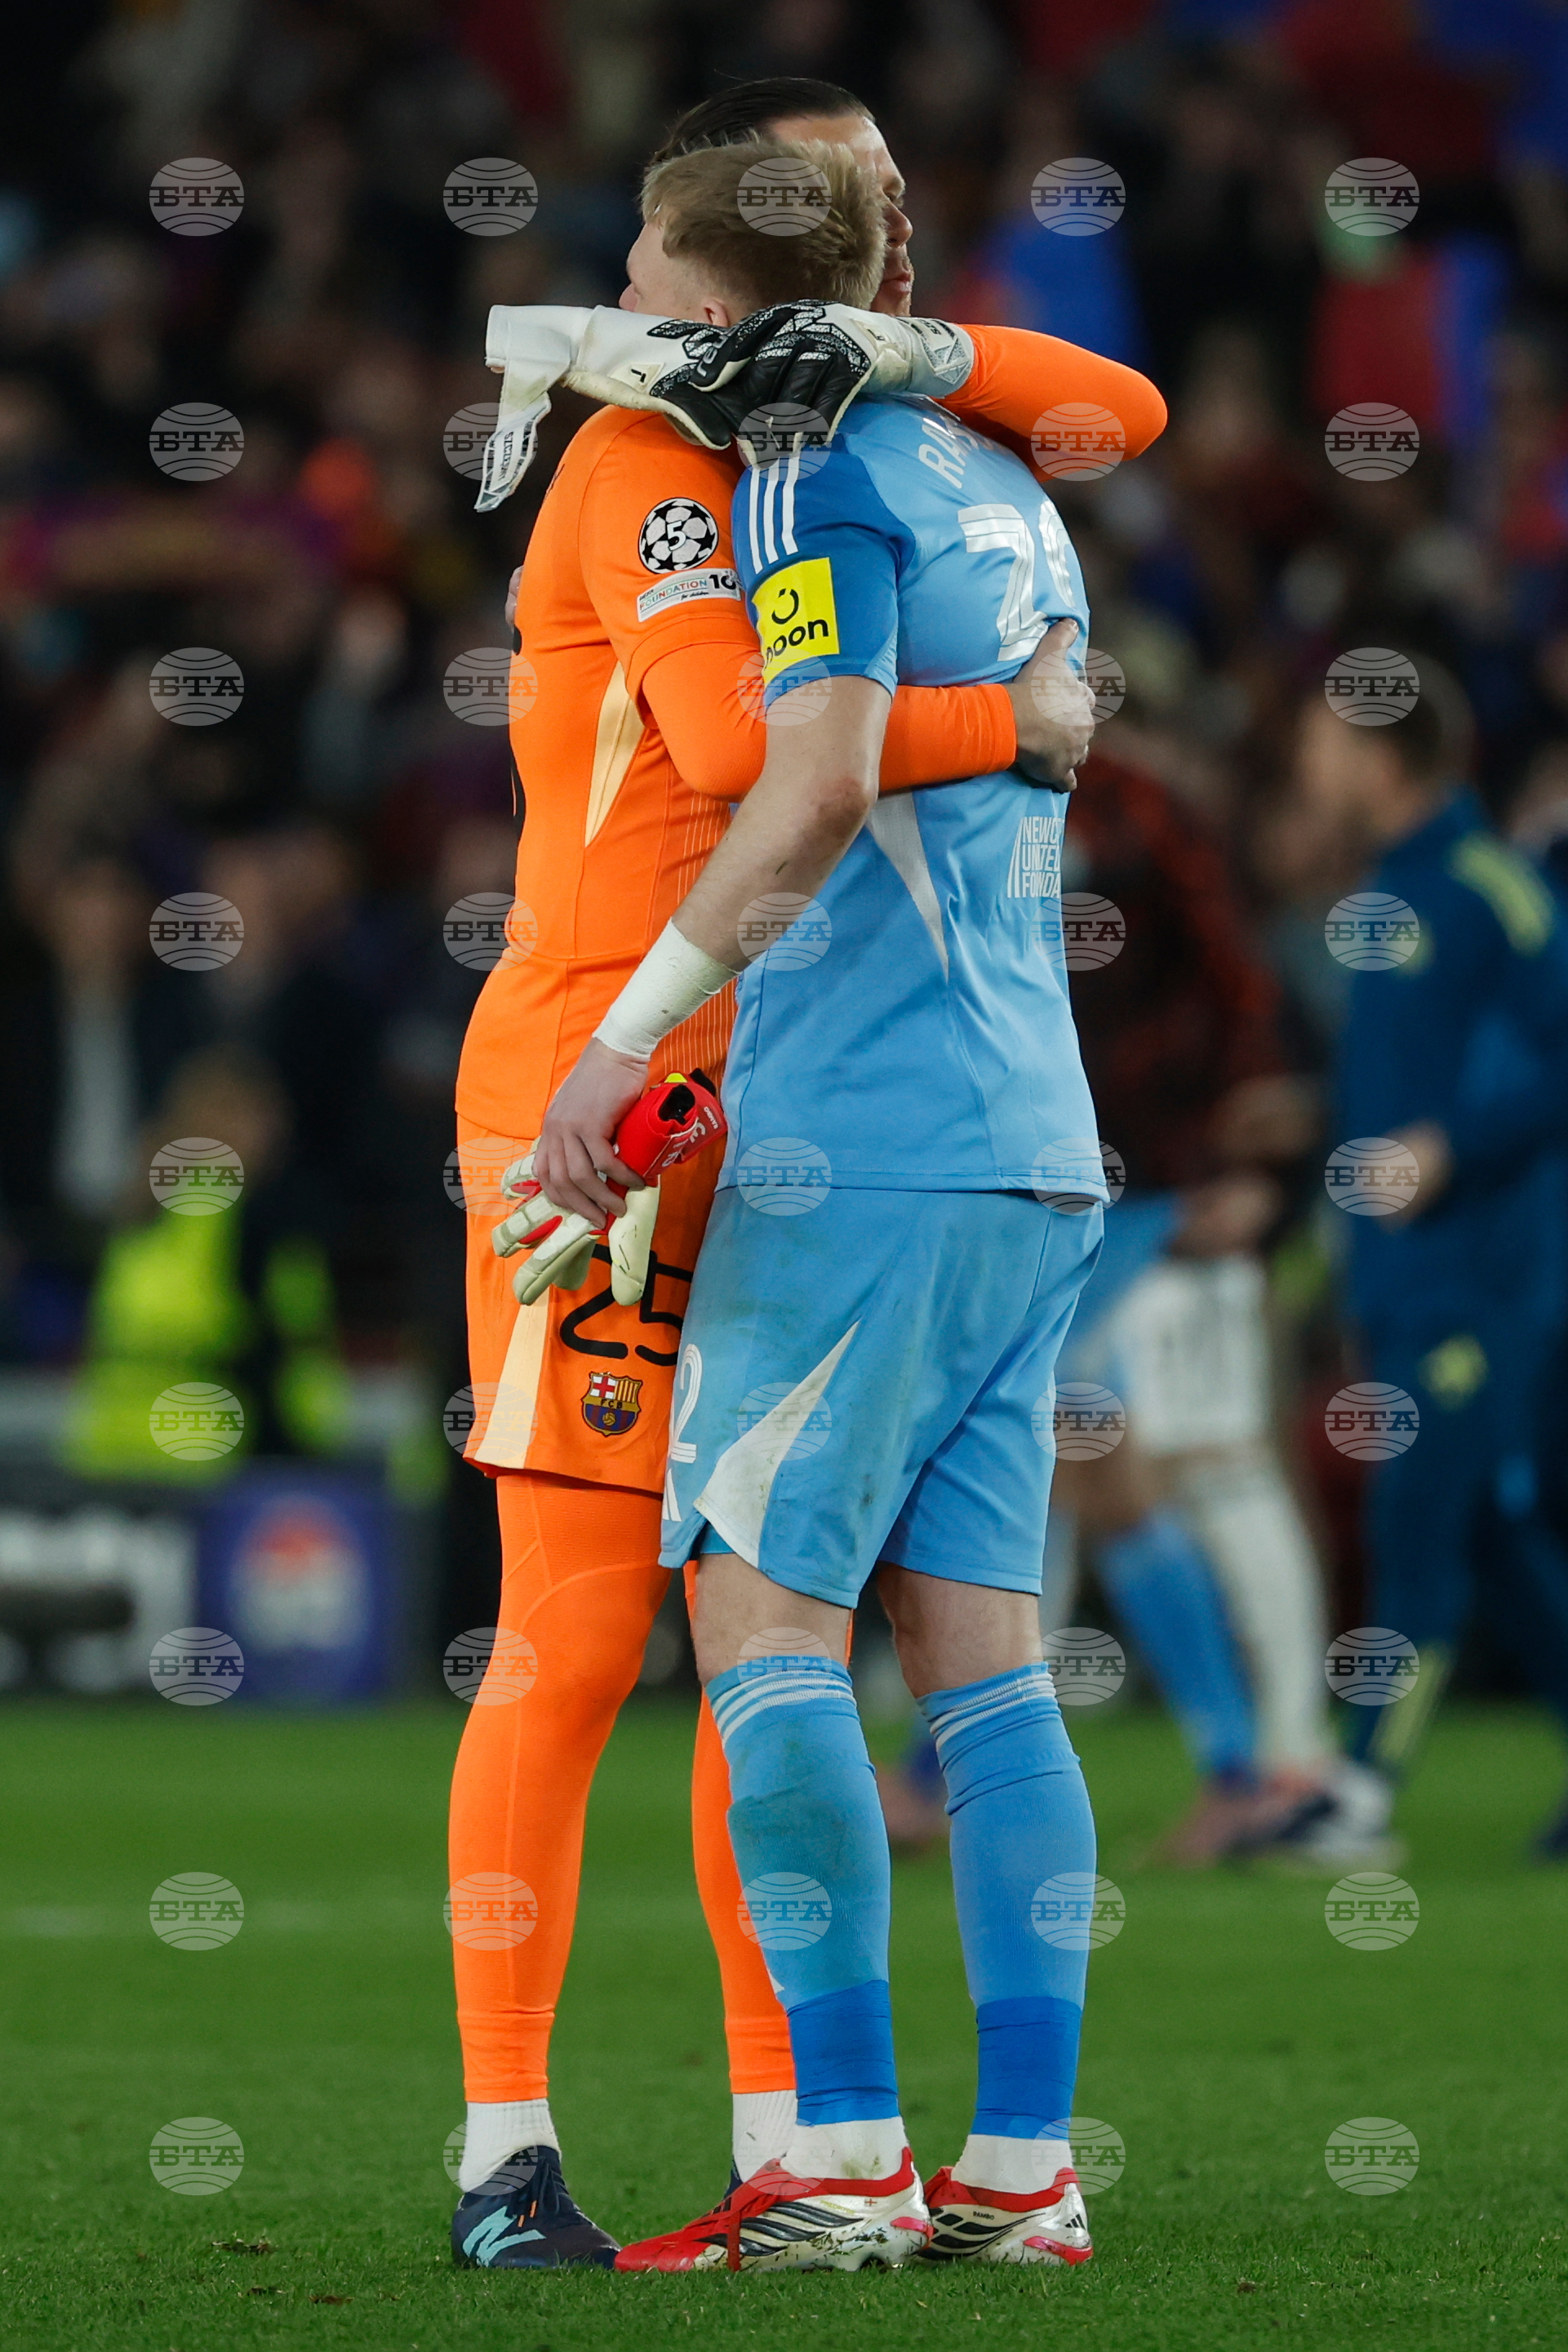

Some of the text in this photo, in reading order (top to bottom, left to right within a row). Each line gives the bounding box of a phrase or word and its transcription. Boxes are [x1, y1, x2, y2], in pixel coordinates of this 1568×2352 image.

[667, 519, 687, 551] 5
[639, 579, 708, 611] FOUNDATION
[559, 1243, 694, 1367] 25
